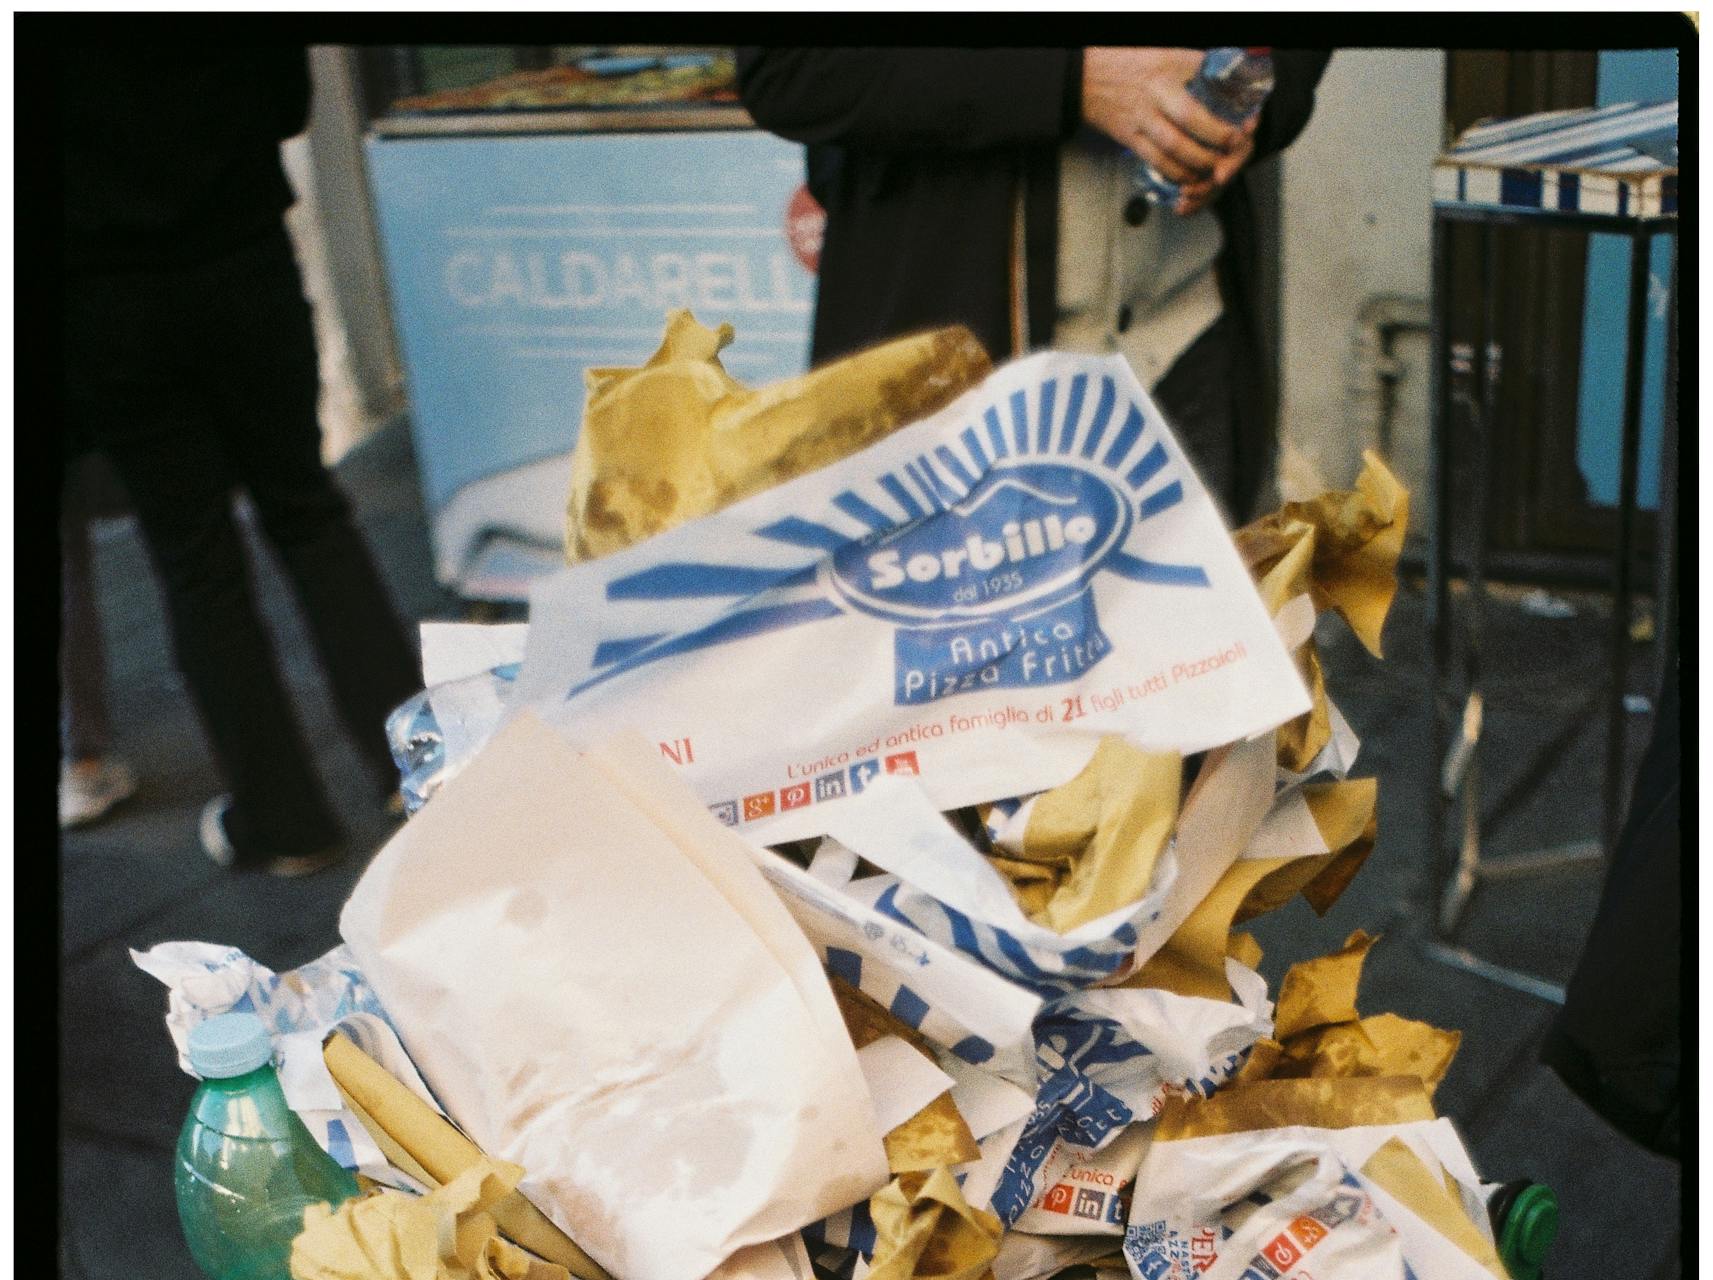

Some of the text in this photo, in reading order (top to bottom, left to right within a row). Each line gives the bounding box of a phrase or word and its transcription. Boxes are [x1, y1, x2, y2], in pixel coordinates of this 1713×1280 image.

[868, 514, 1097, 590] Sorbillo
[954, 572, 1024, 601] dal 1935
[951, 623, 1073, 665] Antica
[904, 663, 999, 698] Pizza
[787, 640, 1248, 779] L'unica ed antica famiglia di 21 figli tutti Pizzaioli
[659, 737, 695, 766] NI
